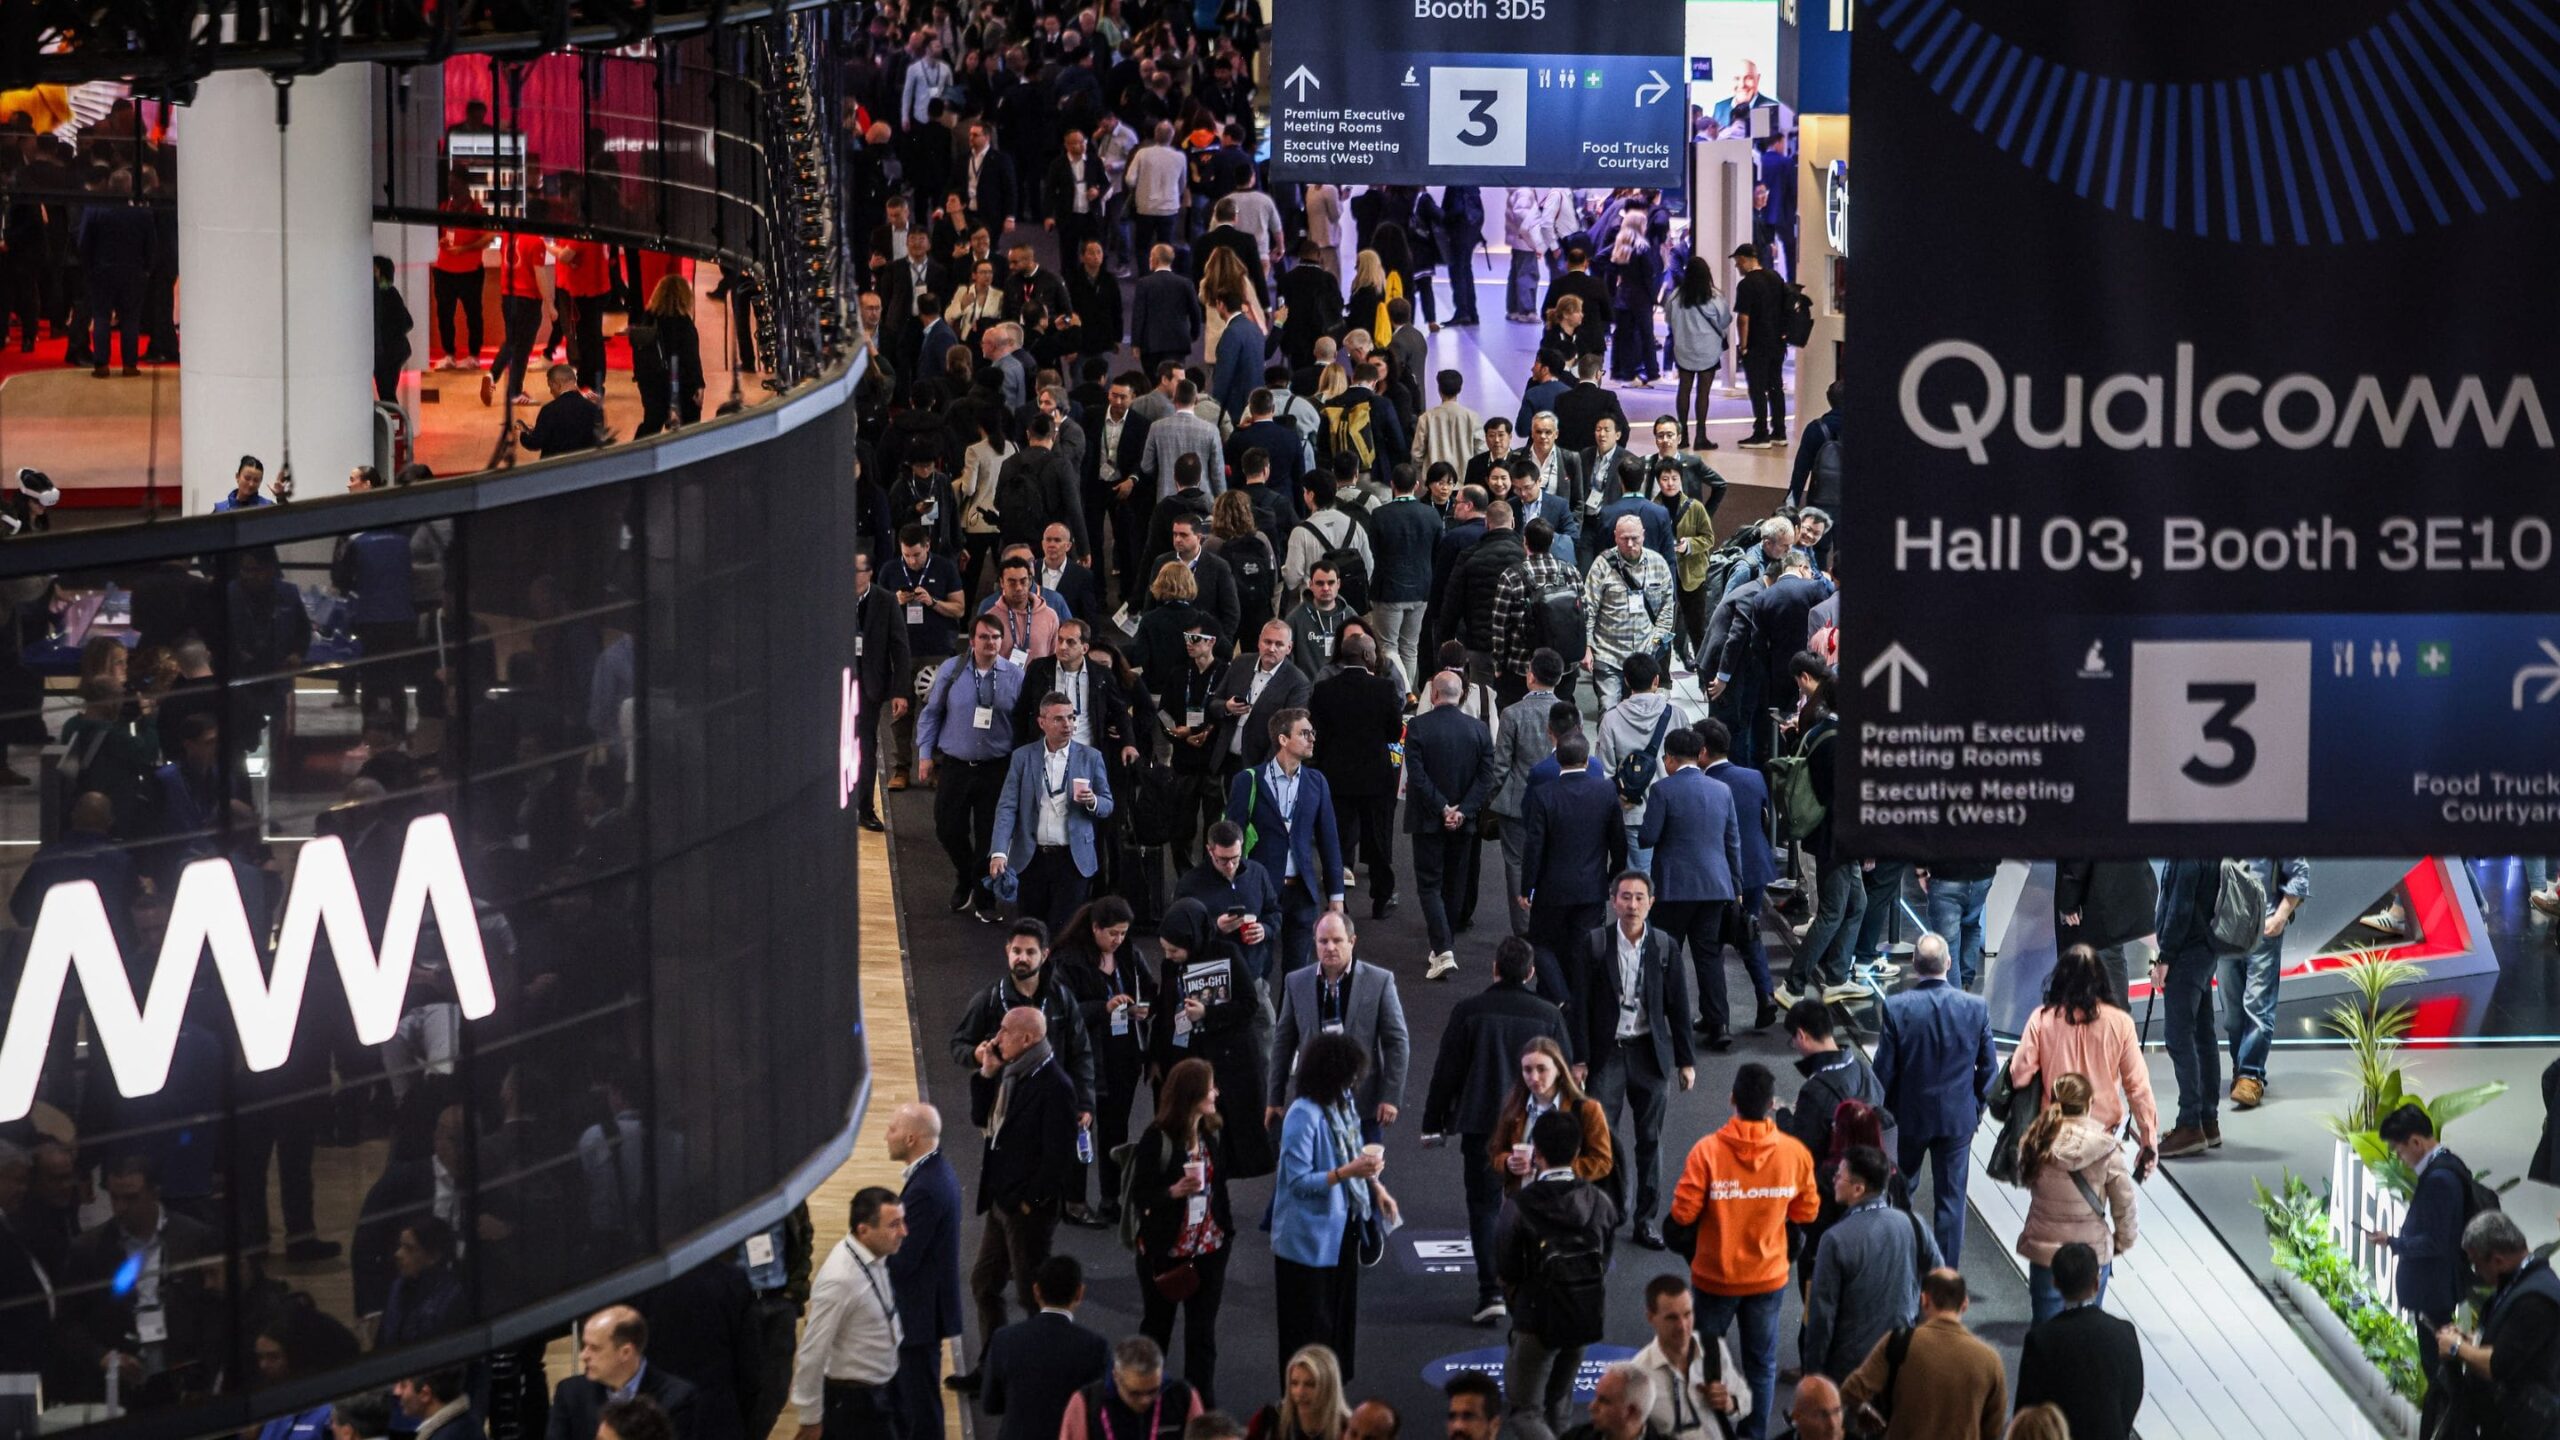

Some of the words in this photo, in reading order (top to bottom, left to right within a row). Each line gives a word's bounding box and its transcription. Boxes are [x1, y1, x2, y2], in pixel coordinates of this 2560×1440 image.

[1414, 0, 1487, 19] Booth
[1496, 0, 1546, 20] 3D5
[1284, 109, 1340, 120] Premium
[1344, 110, 1405, 120] Executive
[1456, 90, 1498, 147] 3
[1284, 122, 1335, 134] Meeting
[1339, 122, 1382, 133] Rooms
[1283, 140, 1345, 151] Executive
[1349, 141, 1400, 153] Meeting
[1583, 142, 1619, 154] Food
[1624, 142, 1669, 154] Trucks
[1283, 153, 1327, 163] Rooms
[1330, 153, 1374, 165] (West)
[1598, 157, 1669, 170] Courtyard
[1898, 338, 2555, 466] Qualcomm
[1895, 514, 2021, 571] Hall
[2040, 516, 2143, 580] 03,
[2163, 514, 2357, 571] Booth
[2378, 515, 2553, 571] 3E10
[1861, 721, 1965, 744] Premium
[1971, 721, 2086, 744] Executive
[2181, 683, 2257, 788] 3
[1860, 746, 1955, 769] Meeting
[1961, 746, 2043, 767] Rooms
[1860, 780, 1973, 801] Executive
[1980, 780, 2075, 803] Meeting
[2413, 771, 2480, 796] Food
[1859, 804, 1940, 824] Rooms
[1946, 804, 2027, 826] (West)
[2441, 799, 2560, 826] Courtyar
